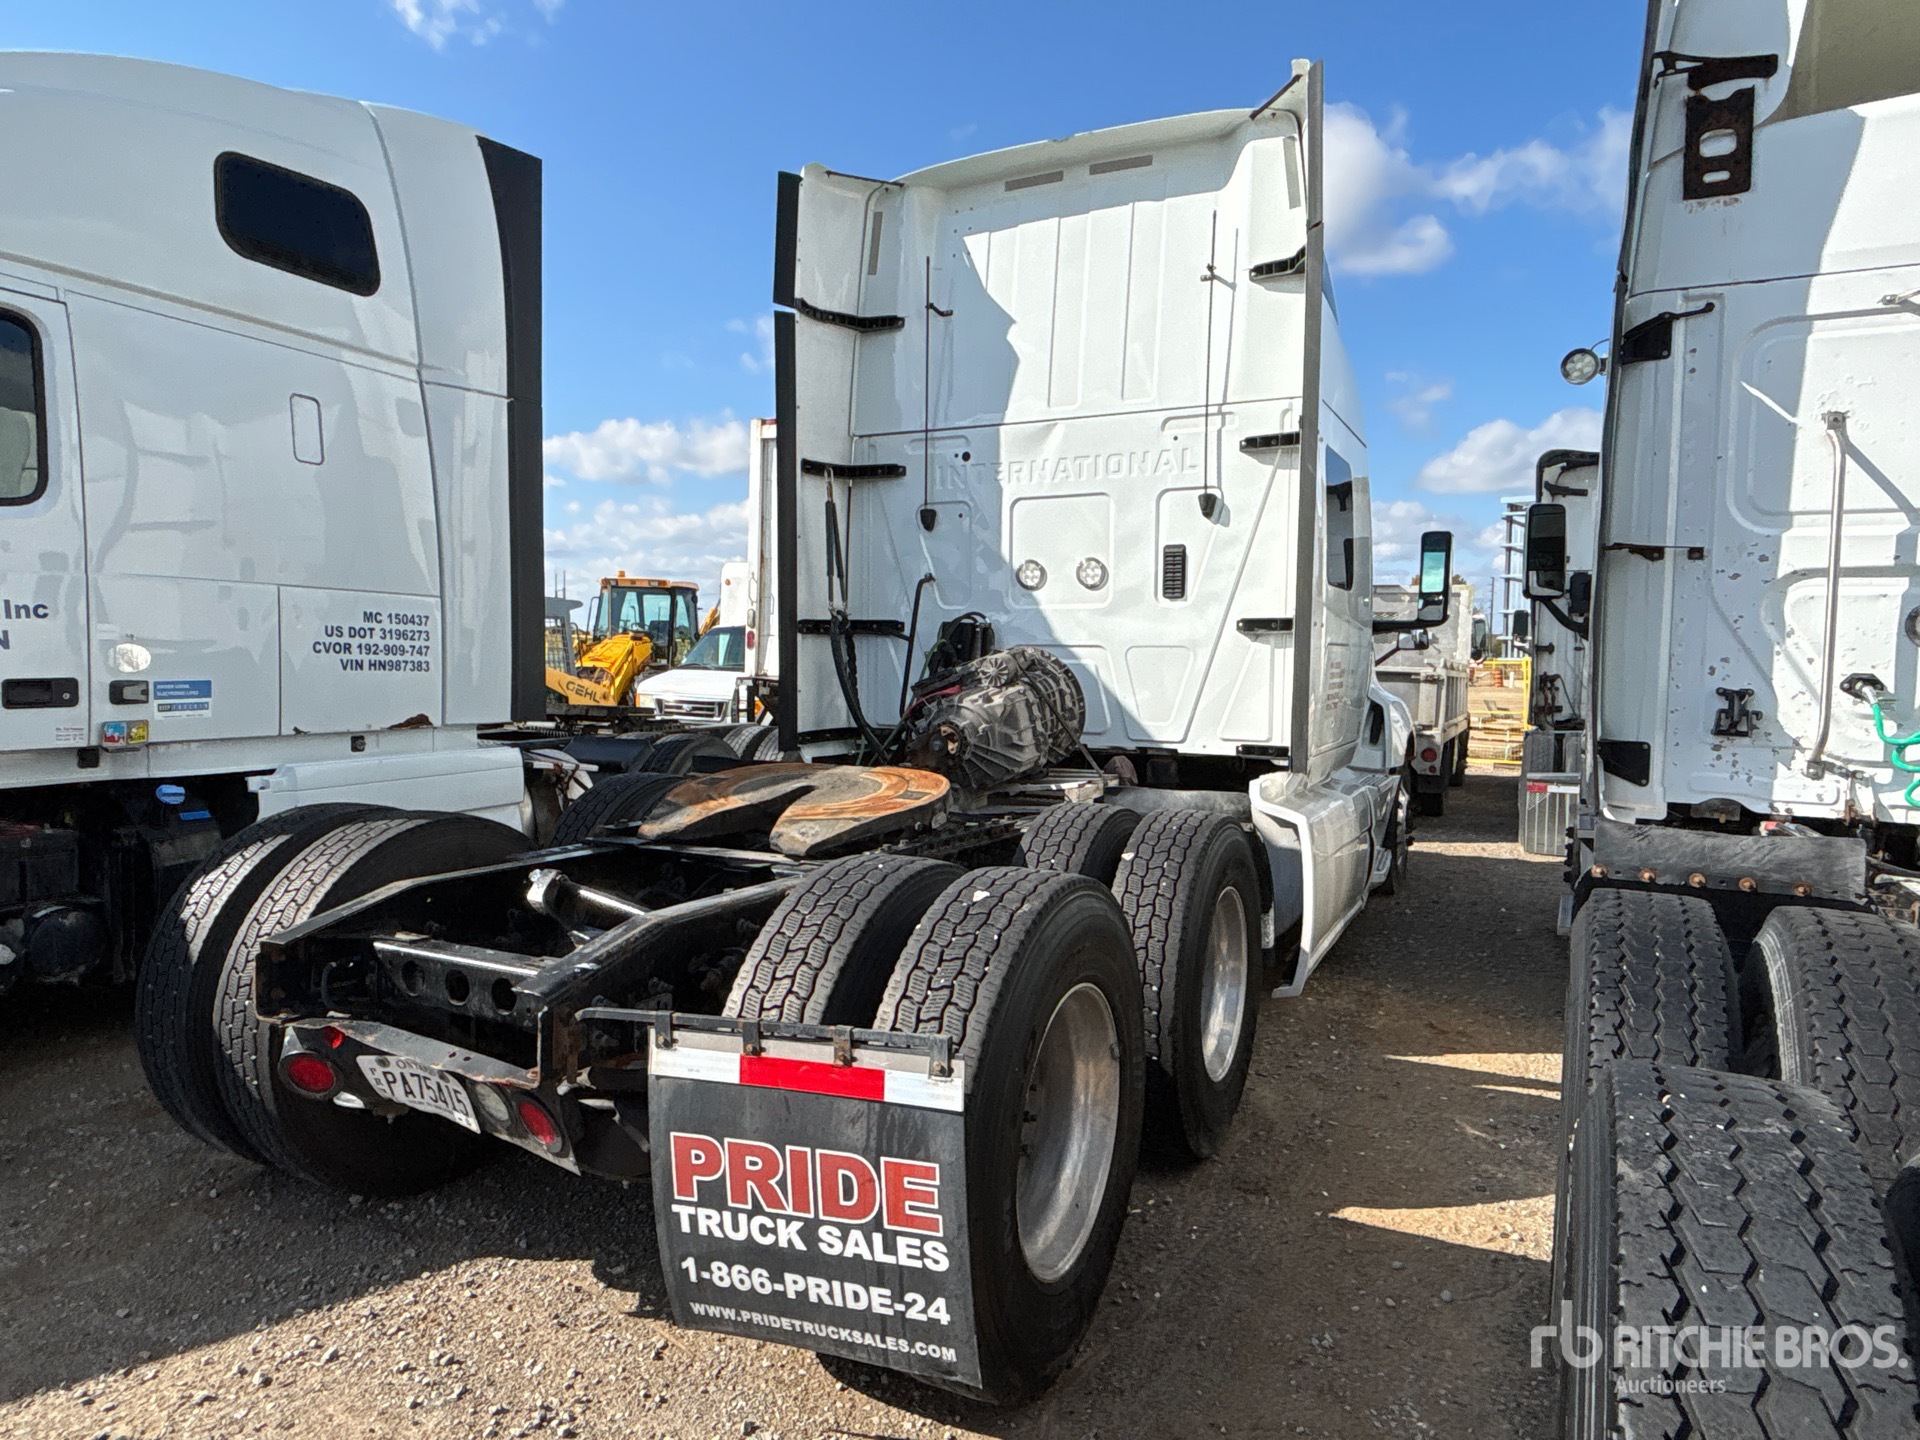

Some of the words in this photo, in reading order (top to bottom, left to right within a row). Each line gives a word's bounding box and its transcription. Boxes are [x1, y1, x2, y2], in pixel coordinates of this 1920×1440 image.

[934, 447, 1199, 490] INTERNATIONAL
[3, 599, 49, 619] Inc
[363, 611, 383, 624] MC
[387, 613, 430, 626] 150437
[324, 625, 344, 638] US
[348, 626, 376, 639] DOT
[379, 628, 430, 642] 3196273
[312, 641, 352, 655] CVOR
[356, 643, 430, 657] 192-909-747
[340, 659, 364, 671] VIN
[368, 660, 430, 672] HN987383
[566, 681, 600, 703] GEHL
[670, 1131, 944, 1237] PRIDE
[671, 1204, 807, 1251] TRUCK
[818, 1225, 950, 1272] SALES
[681, 1256, 951, 1326] 1-866-PRIDE-24
[689, 1301, 958, 1363] WWW.PRIDETRUCKSALES.COM
